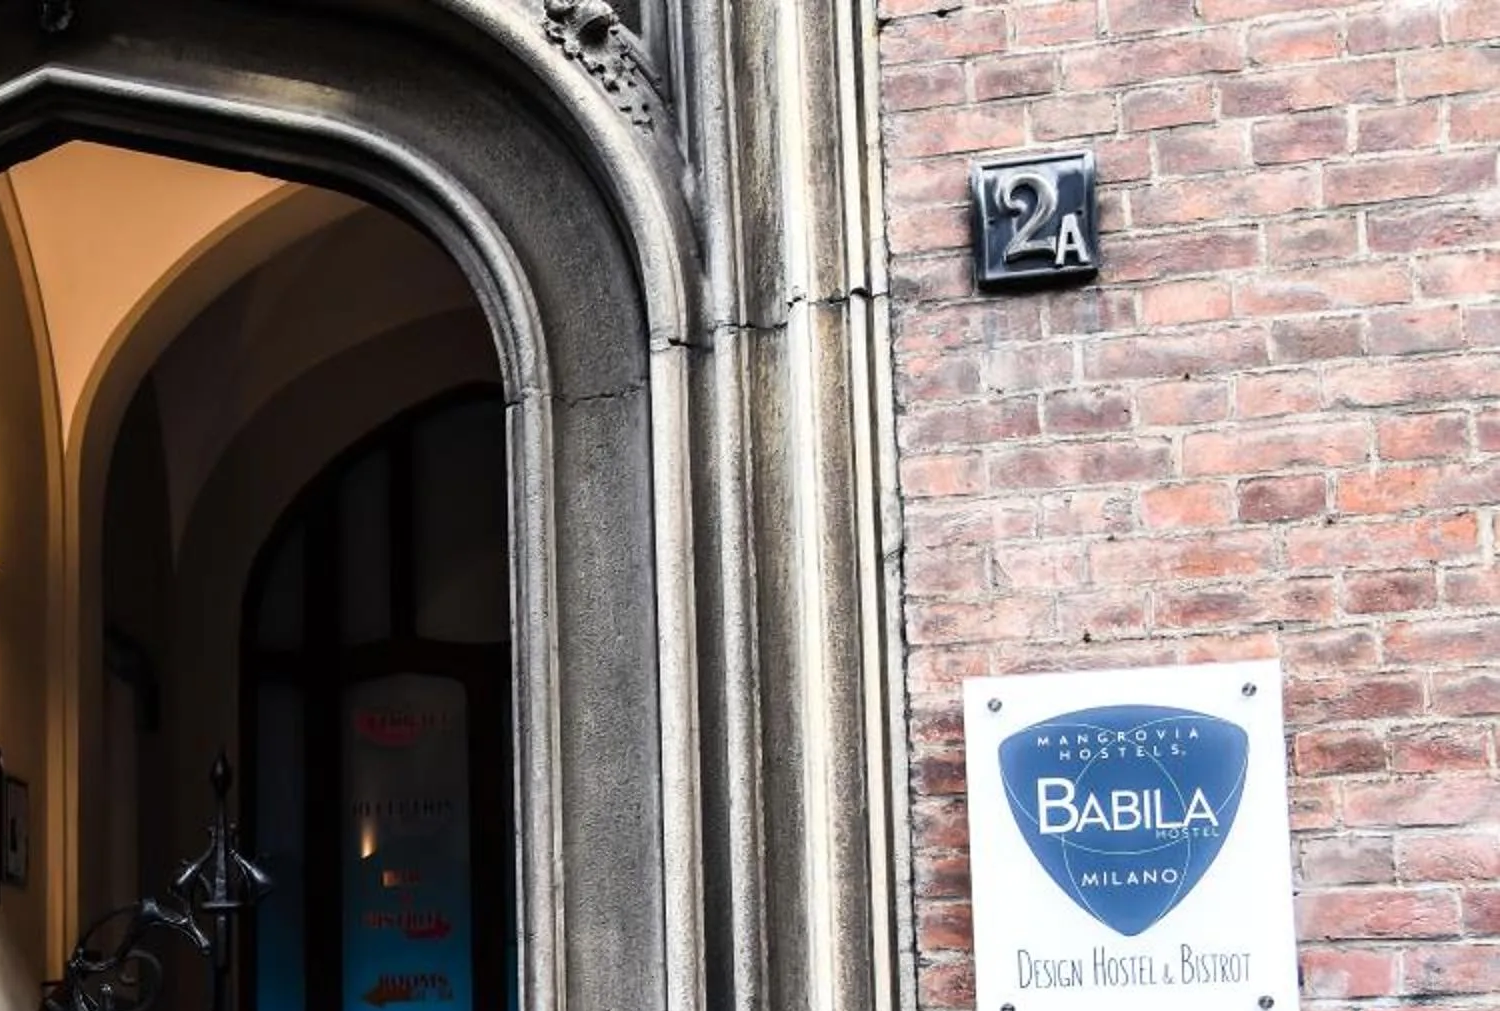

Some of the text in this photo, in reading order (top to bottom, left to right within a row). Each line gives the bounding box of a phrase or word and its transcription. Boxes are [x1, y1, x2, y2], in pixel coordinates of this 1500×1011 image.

[1003, 173, 1092, 265] 2A
[1037, 727, 1200, 747] MANGROVIA
[1037, 776, 1220, 835] BABILA
[1155, 827, 1221, 839] HOSTEL
[1081, 868, 1179, 888] MILANO
[1016, 944, 1251, 989] DESIGN HOSTEL & BISTROT
